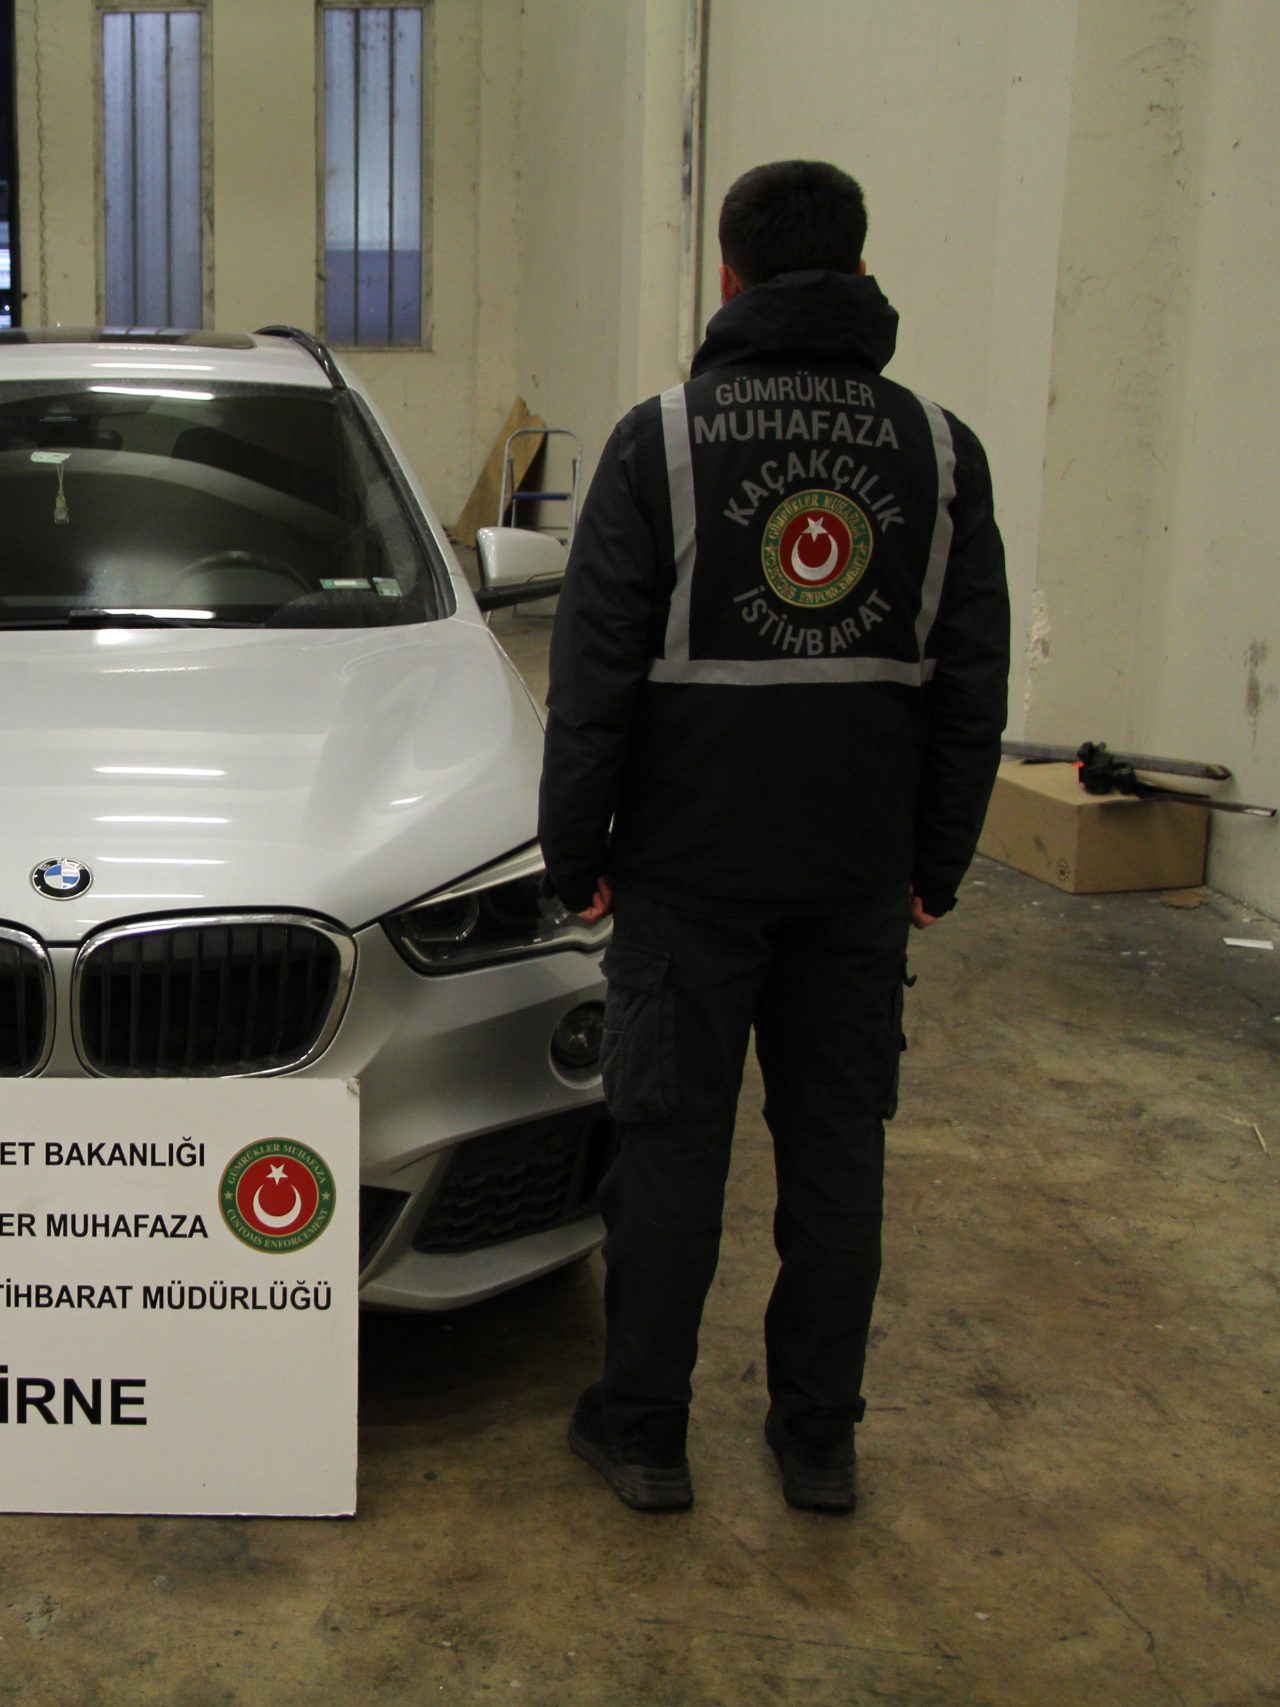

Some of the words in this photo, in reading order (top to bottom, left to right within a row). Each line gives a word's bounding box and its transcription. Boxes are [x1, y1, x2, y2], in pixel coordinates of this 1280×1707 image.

[715, 370, 875, 409] GÜMRÜKLER
[695, 409, 900, 449] MUHAFAZA
[723, 449, 904, 533] KAÇAKÇILIK
[733, 585, 892, 656] İSTİHBARAT
[46, 1136, 205, 1167] BAKANLIĞI
[228, 1143, 281, 1184] GÜMRÜKLER
[283, 1144, 328, 1184] MUHAFAZA
[47, 1213, 209, 1239] MUHAFAZA
[226, 1208, 263, 1246] CUSTOMS
[264, 1209, 329, 1249] ENFORCEMENT
[142, 1280, 332, 1311] MÜDÜRLÜĞÜ
